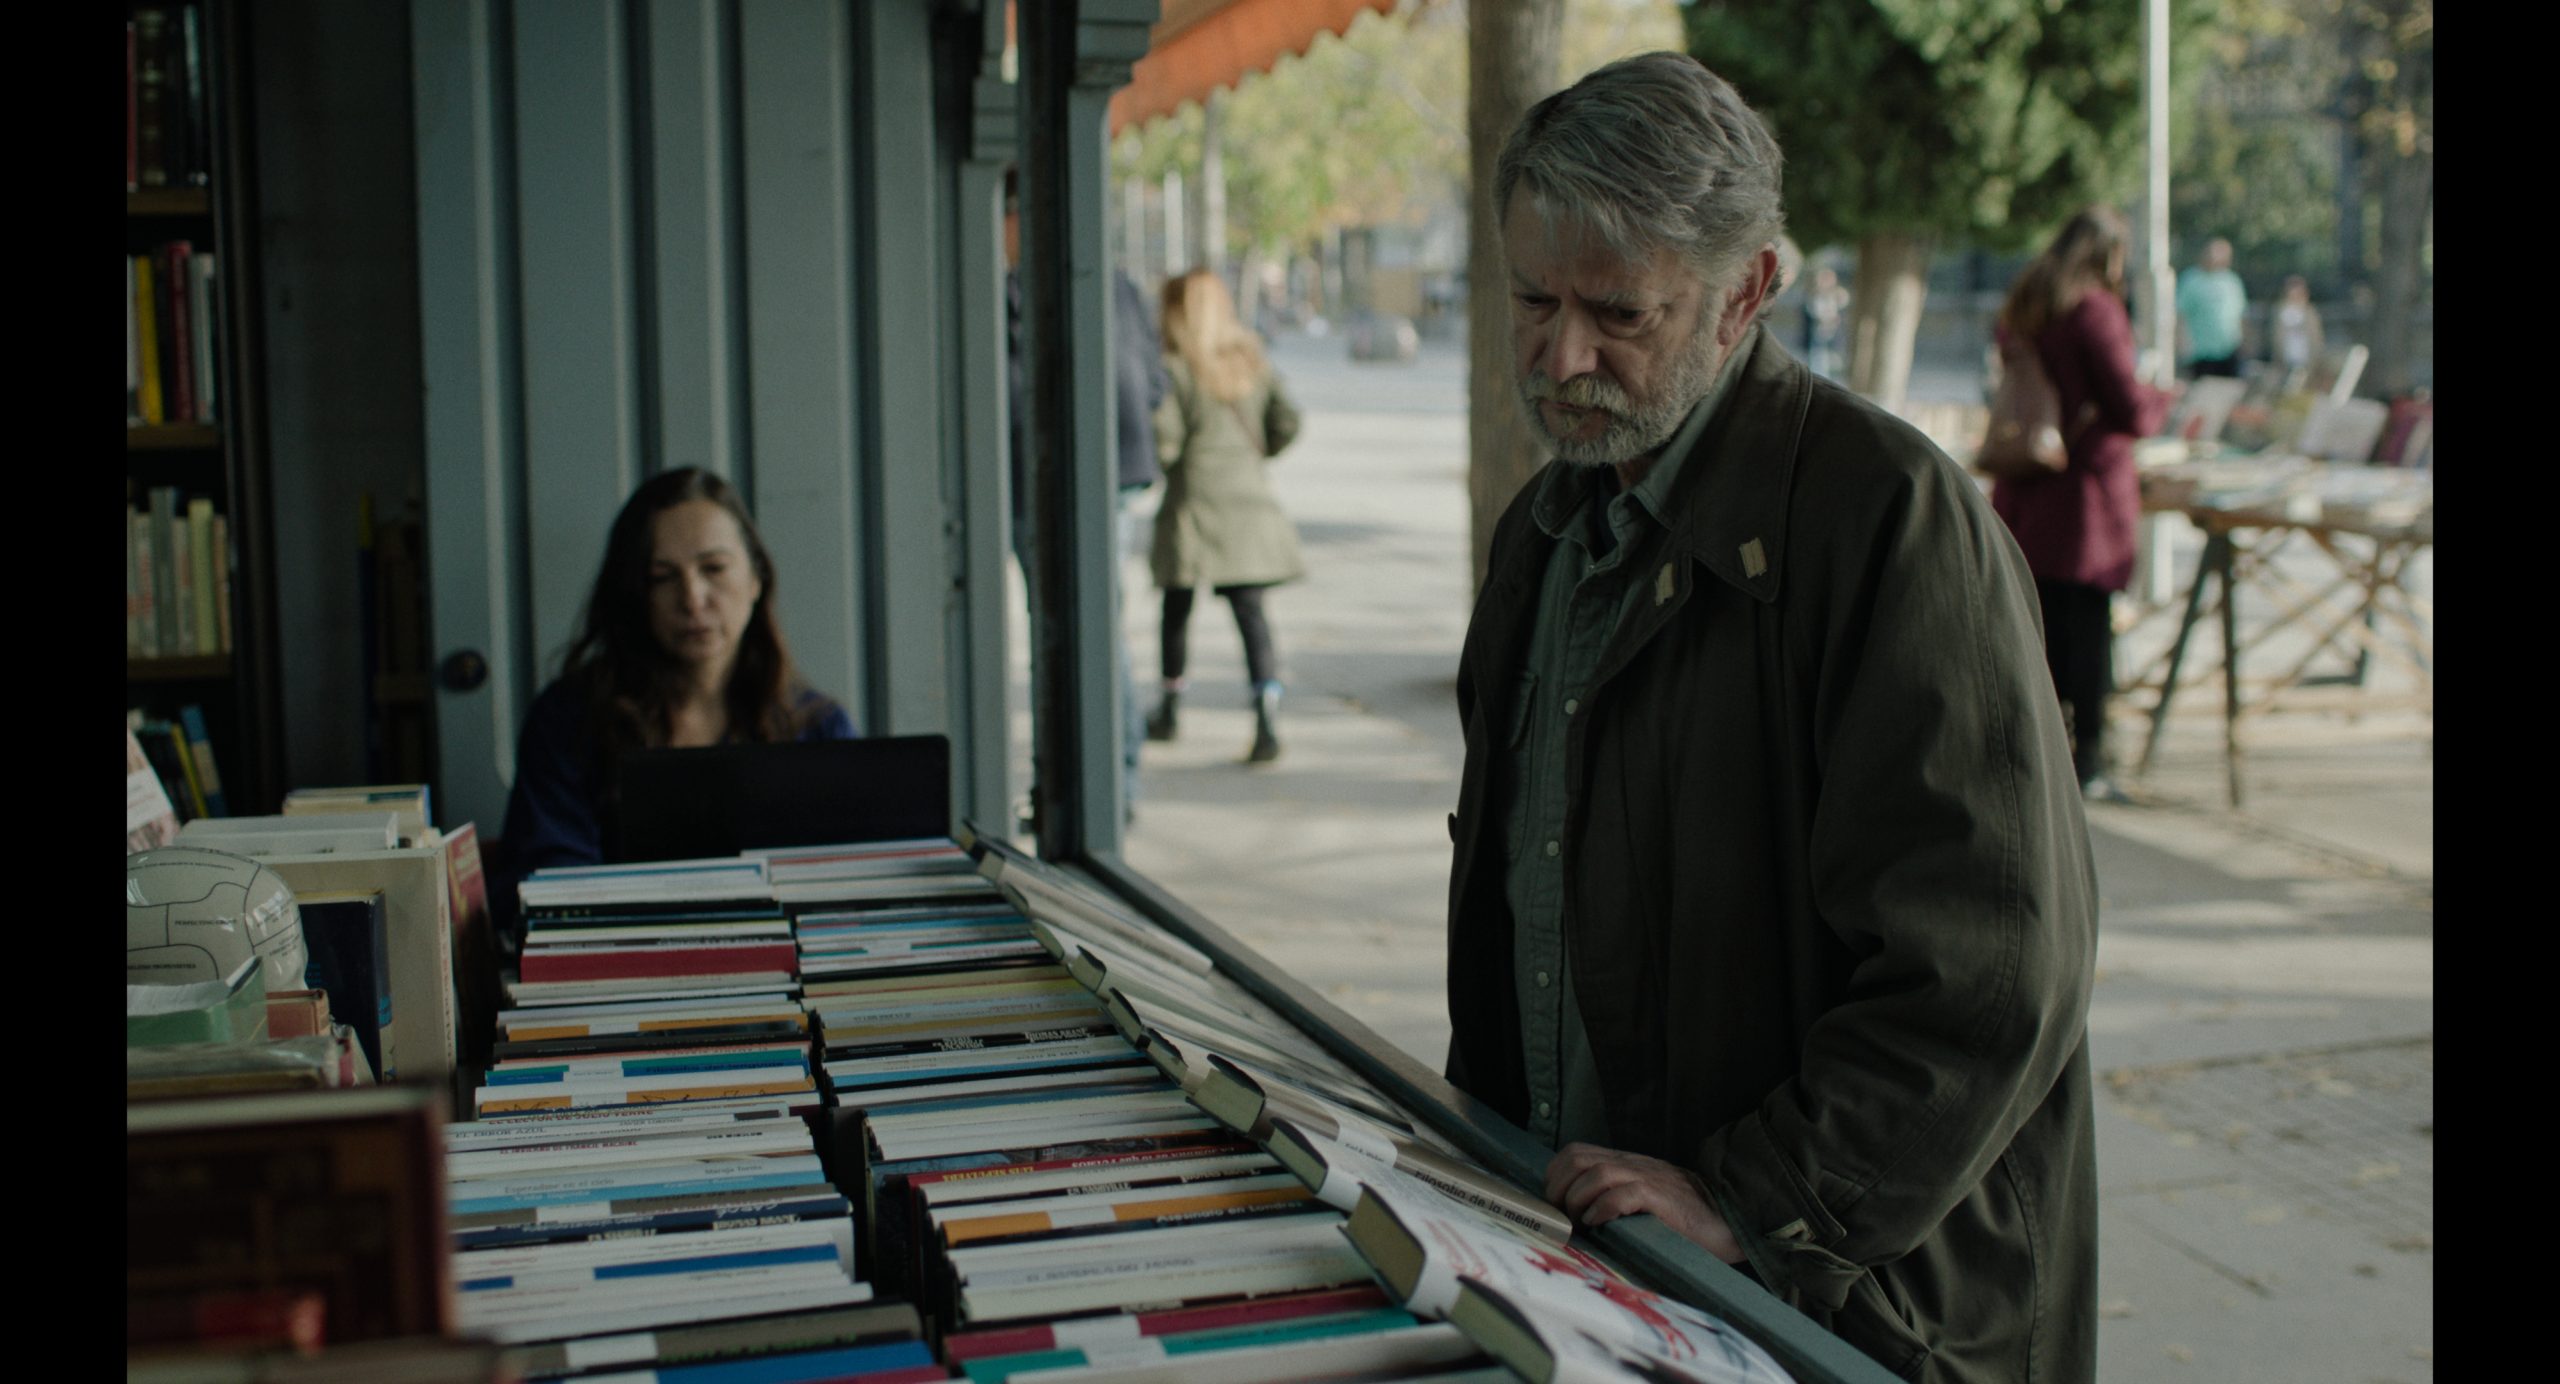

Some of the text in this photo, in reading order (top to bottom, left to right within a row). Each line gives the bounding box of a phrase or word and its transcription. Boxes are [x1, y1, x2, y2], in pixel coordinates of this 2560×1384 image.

[474, 1128, 512, 1138] ERROR
[516, 1126, 548, 1136] AZUL
[1226, 1204, 1246, 1216] en
[1468, 1193, 1487, 1208] de
[1487, 1199, 1502, 1214] la
[1503, 1207, 1542, 1233] mente
